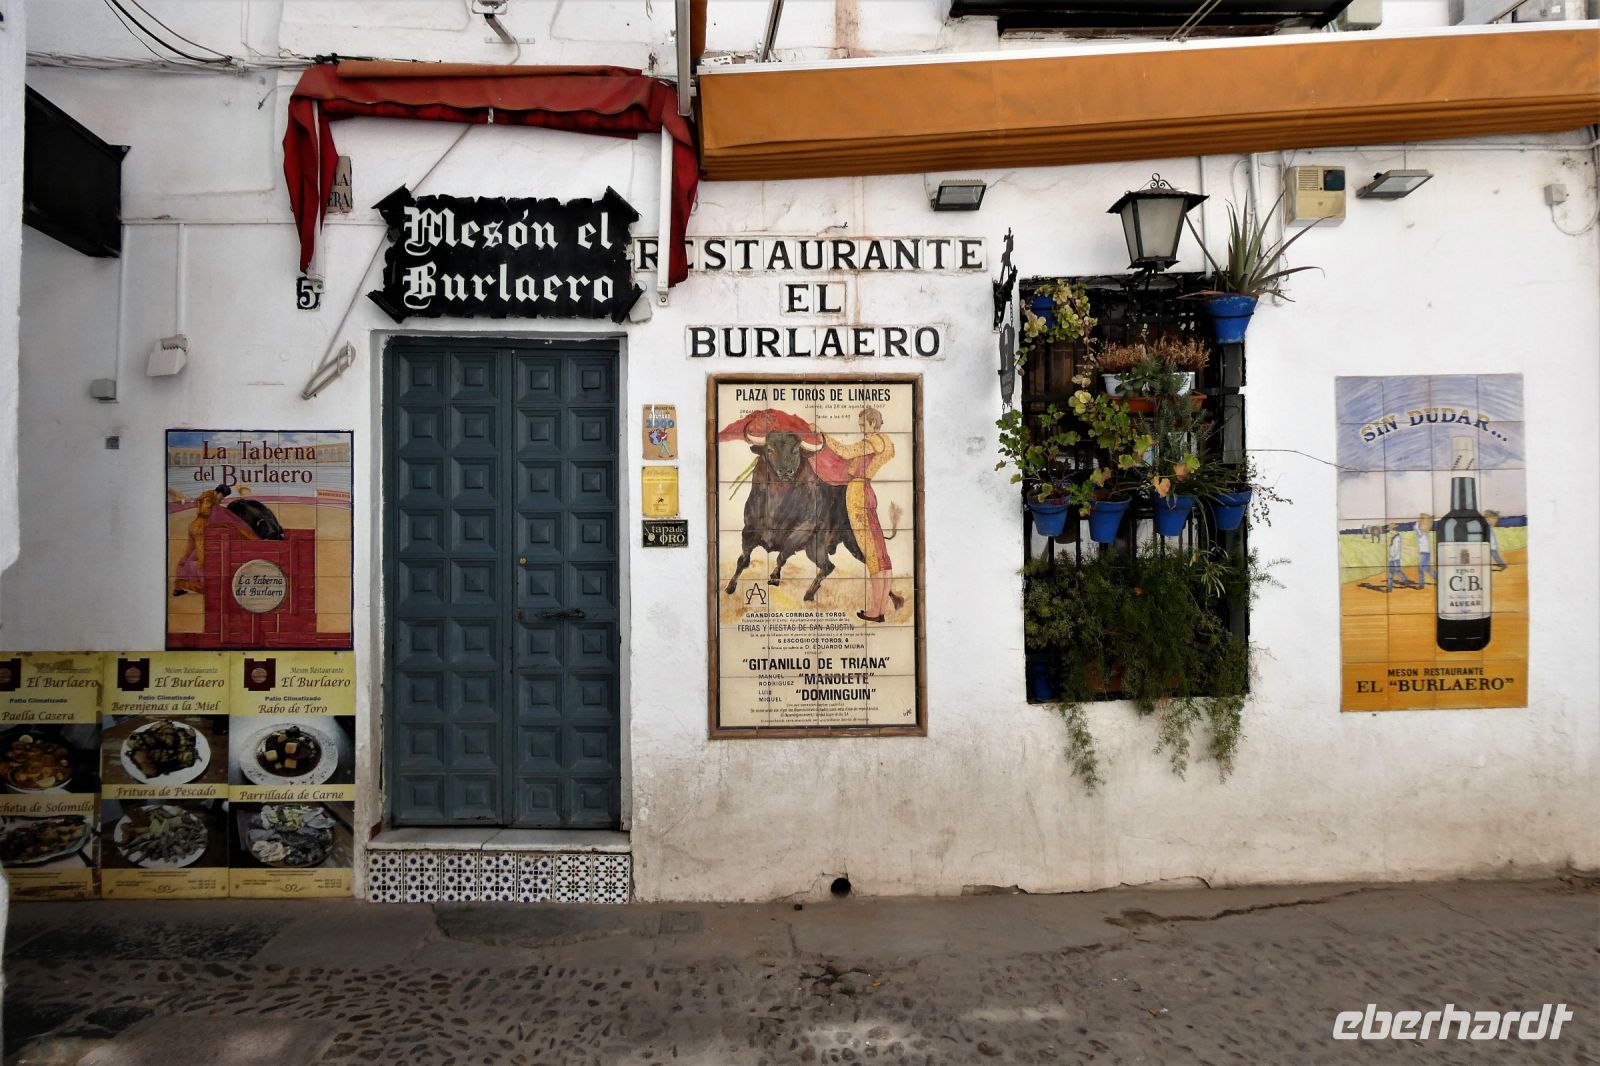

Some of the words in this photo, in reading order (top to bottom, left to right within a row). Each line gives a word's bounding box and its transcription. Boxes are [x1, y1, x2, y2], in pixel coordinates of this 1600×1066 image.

[403, 206, 558, 256] Mesón
[577, 211, 613, 249] el
[637, 238, 983, 269] RSTAURANTE
[403, 261, 614, 309] Burlaero
[787, 283, 842, 313] EL
[688, 326, 941, 358] BURLAERO
[736, 389, 768, 401] PLAZA
[773, 389, 786, 401] DE
[792, 388, 825, 401] TOROS
[830, 388, 843, 401] DE
[848, 388, 891, 401] LINARES
[1360, 415, 1398, 442] SIN
[202, 441, 227, 460] La
[237, 440, 316, 460] Taberna
[194, 466, 215, 481] del
[221, 464, 313, 487] Burlaero
[238, 575, 250, 584] La
[253, 574, 283, 585] Taberna
[1449, 575, 1483, 592] C.B.
[737, 624, 760, 632] FERIAS
[761, 624, 767, 632] Y
[769, 624, 796, 632] FIESTAS
[742, 657, 811, 670] "GITANILLO
[818, 657, 833, 669] DE
[840, 656, 890, 669] TRIANA"
[798, 672, 875, 685] "MANOLETE"
[1387, 668, 1419, 677] MESON
[1423, 667, 1484, 677] RESTAURANTE
[26, 675, 40, 688] El
[43, 675, 98, 688] Burlaero
[154, 676, 170, 688] El
[171, 676, 225, 688] Burlaero
[281, 676, 296, 688] El
[297, 675, 351, 688] Burlaero
[1356, 680, 1383, 693] EL
[1389, 678, 1514, 692] "BURLAERO"
[795, 688, 876, 701] "DOMINGUIN"
[111, 701, 168, 713] Berenjenas
[182, 702, 192, 711] la
[194, 701, 219, 711] Miel
[258, 703, 285, 714] Rabo
[288, 703, 301, 714] de
[303, 704, 328, 714] Toro
[1, 710, 35, 721] Paella
[38, 710, 75, 721] Casera
[115, 787, 156, 798] Fritura
[159, 786, 172, 797] de
[174, 786, 216, 797] Pescado
[239, 789, 292, 801] Parrillada
[296, 789, 309, 800] de
[312, 790, 344, 800] Carne
[29, 801, 42, 813] de
[45, 801, 95, 813] Solomillo
